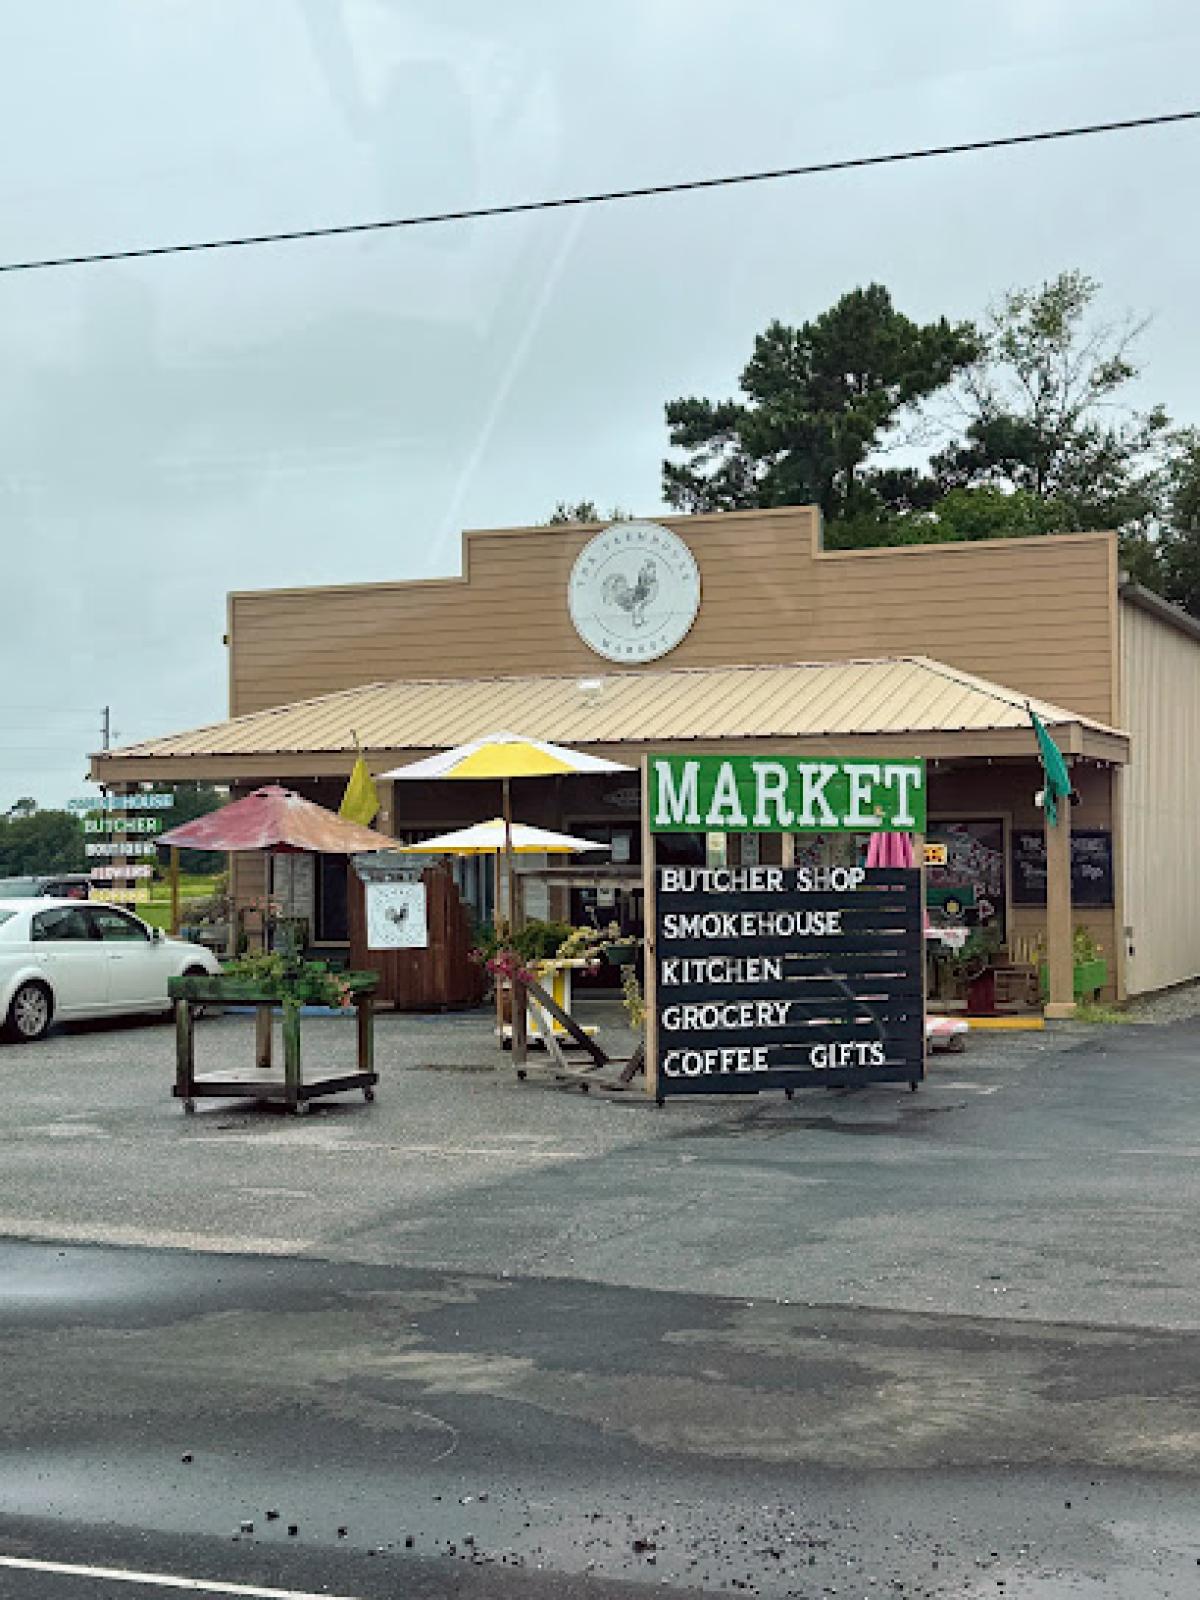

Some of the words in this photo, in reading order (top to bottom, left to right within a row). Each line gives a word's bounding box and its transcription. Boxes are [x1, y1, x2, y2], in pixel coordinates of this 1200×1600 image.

[655, 761, 922, 827] MARKET
[661, 867, 784, 892] BUTCHER
[797, 867, 866, 892] SHOP
[663, 912, 842, 938] SMOKEHOUSE
[661, 957, 783, 986] KITCHEN
[661, 1002, 792, 1030] GROCERY
[663, 1047, 768, 1077] COFFEE
[809, 1042, 886, 1069] GIFTS
